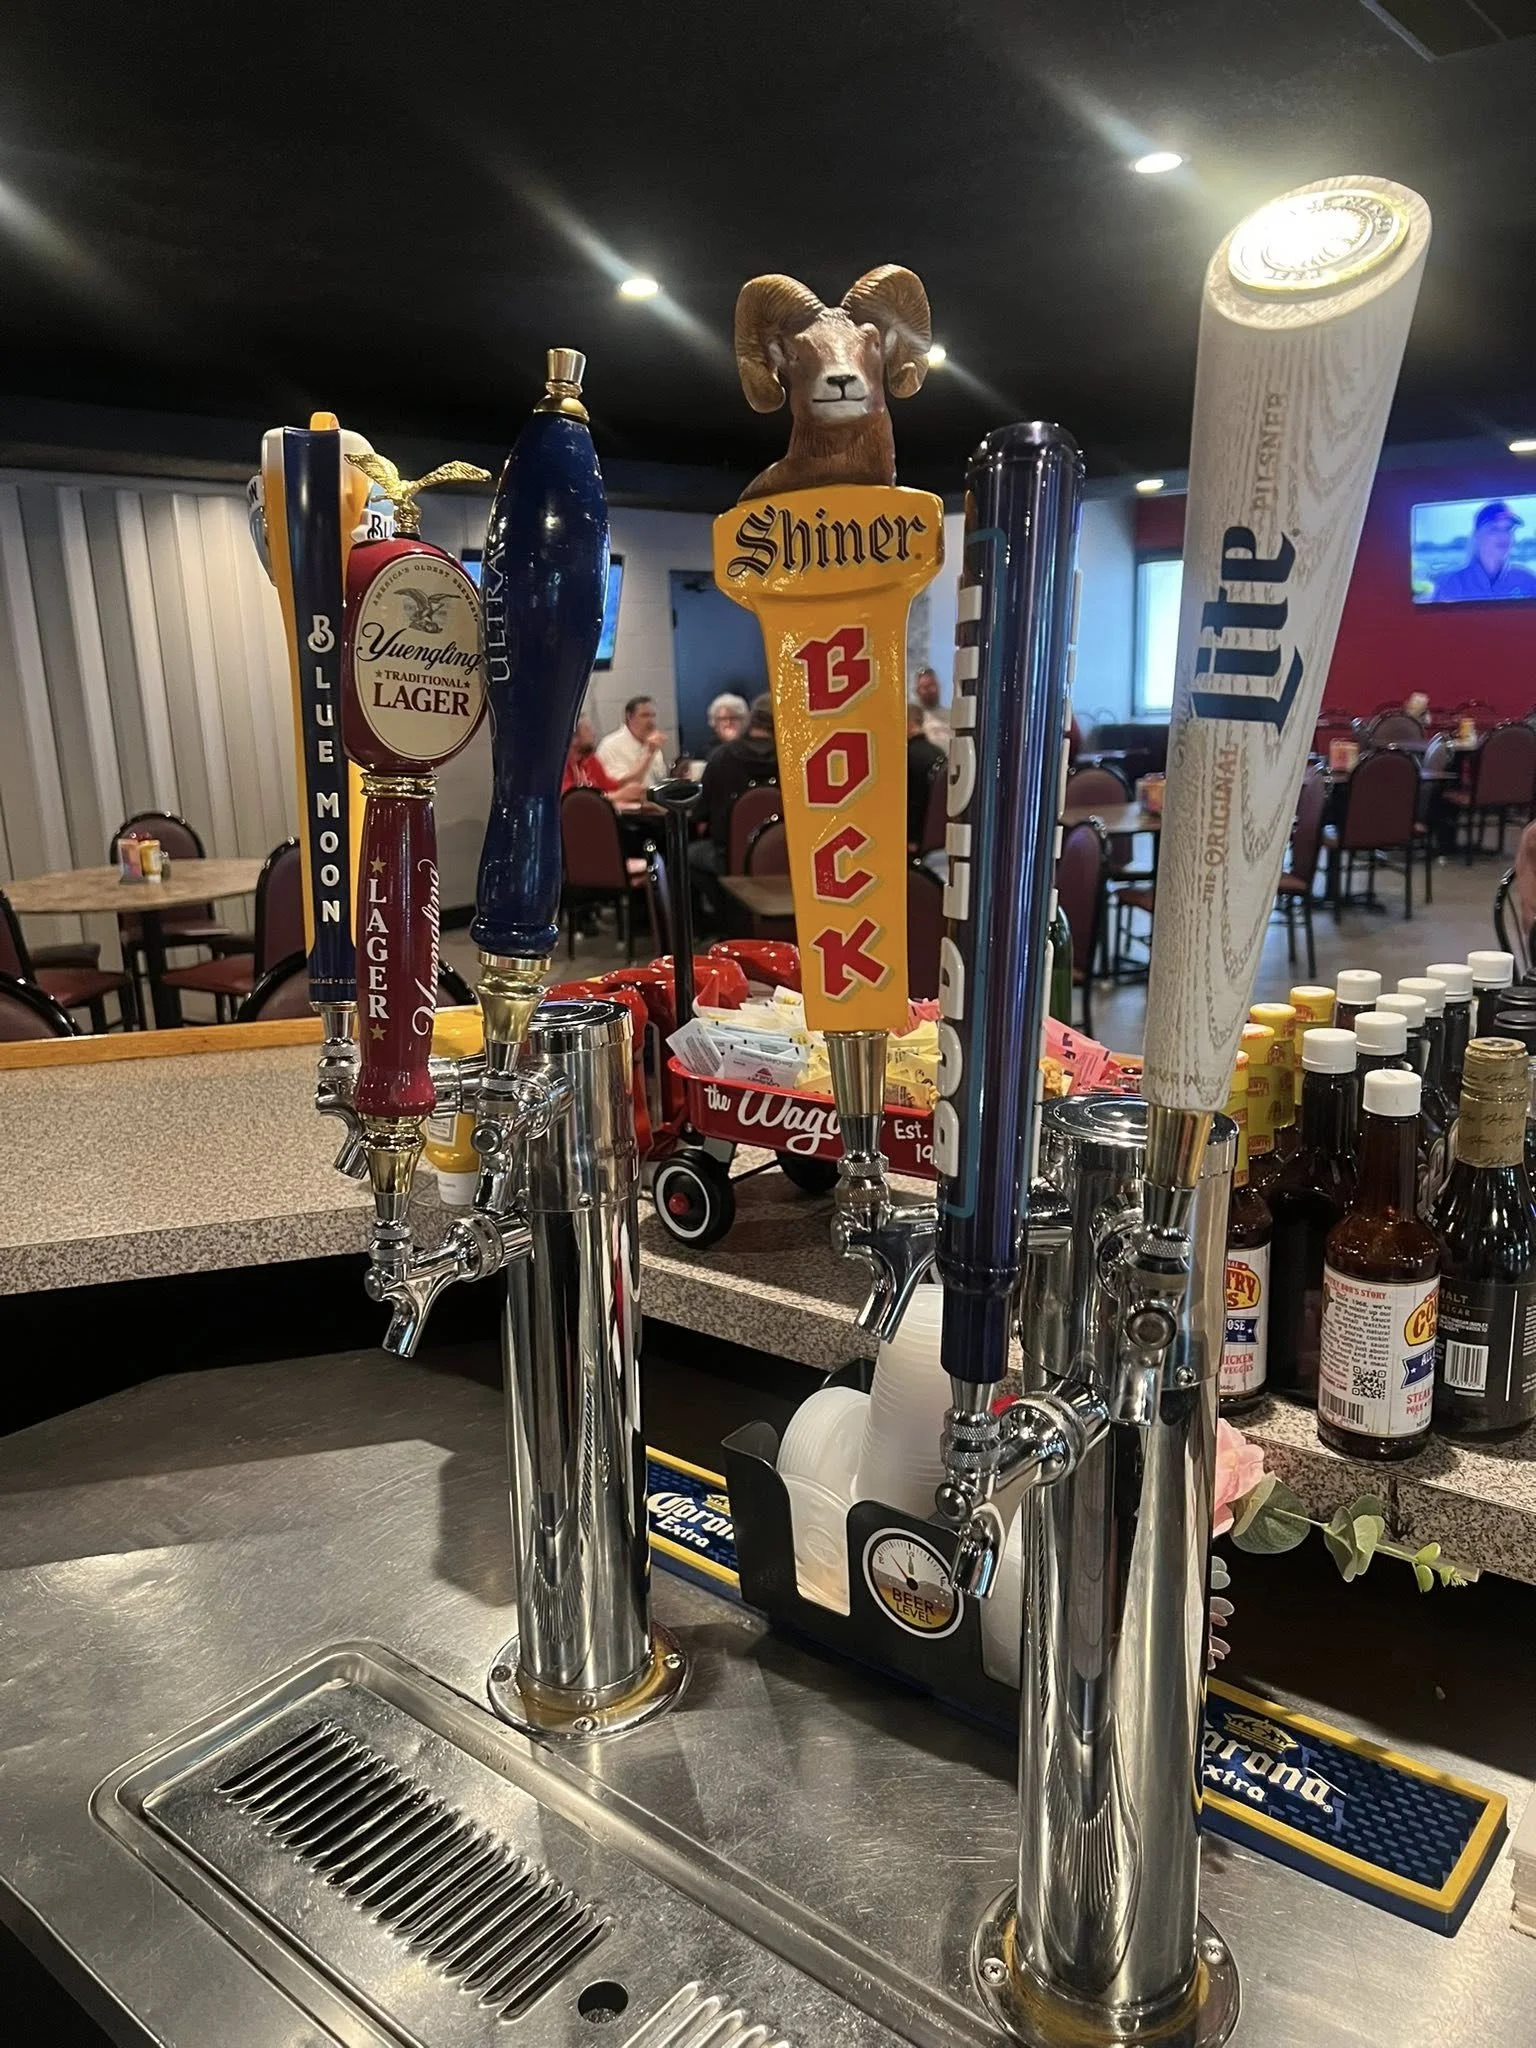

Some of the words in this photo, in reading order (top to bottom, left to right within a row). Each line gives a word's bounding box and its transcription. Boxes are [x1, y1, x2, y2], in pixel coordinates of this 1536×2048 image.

[1251, 392, 1288, 512] PILSNER
[726, 503, 928, 580] Shiner
[414, 564, 451, 579] OLDEST
[486, 541, 511, 683] ULTRA
[356, 621, 482, 676] Yuengling
[1193, 525, 1304, 737] Lite
[307, 613, 335, 764] BLUE
[384, 669, 463, 689] TRADITIONAL
[373, 681, 471, 717] LAGER
[793, 623, 895, 1000] BOCK
[1203, 742, 1239, 869] ORIGINAL
[316, 792, 340, 923] MOON
[365, 877, 390, 1019] LAGER
[704, 1084, 731, 1112] the
[737, 1090, 843, 1155] Wago
[894, 1120, 929, 1140] Est.
[915, 1143, 934, 1164] 19
[1361, 1289, 1387, 1300] STORY
[1344, 1309, 1369, 1320] Purpose
[1371, 1315, 1391, 1323] Sauce
[1363, 1321, 1391, 1330] batches
[1366, 1328, 1391, 1336] natural
[1355, 1344, 1368, 1353] just
[1369, 1347, 1389, 1355] about
[655, 1515, 710, 1548] Extra
[892, 1586, 937, 1617] BEER
[895, 1602, 933, 1625] LEVEL
[1202, 1764, 1266, 1802] xtra
[1203, 1730, 1331, 1806] orona
